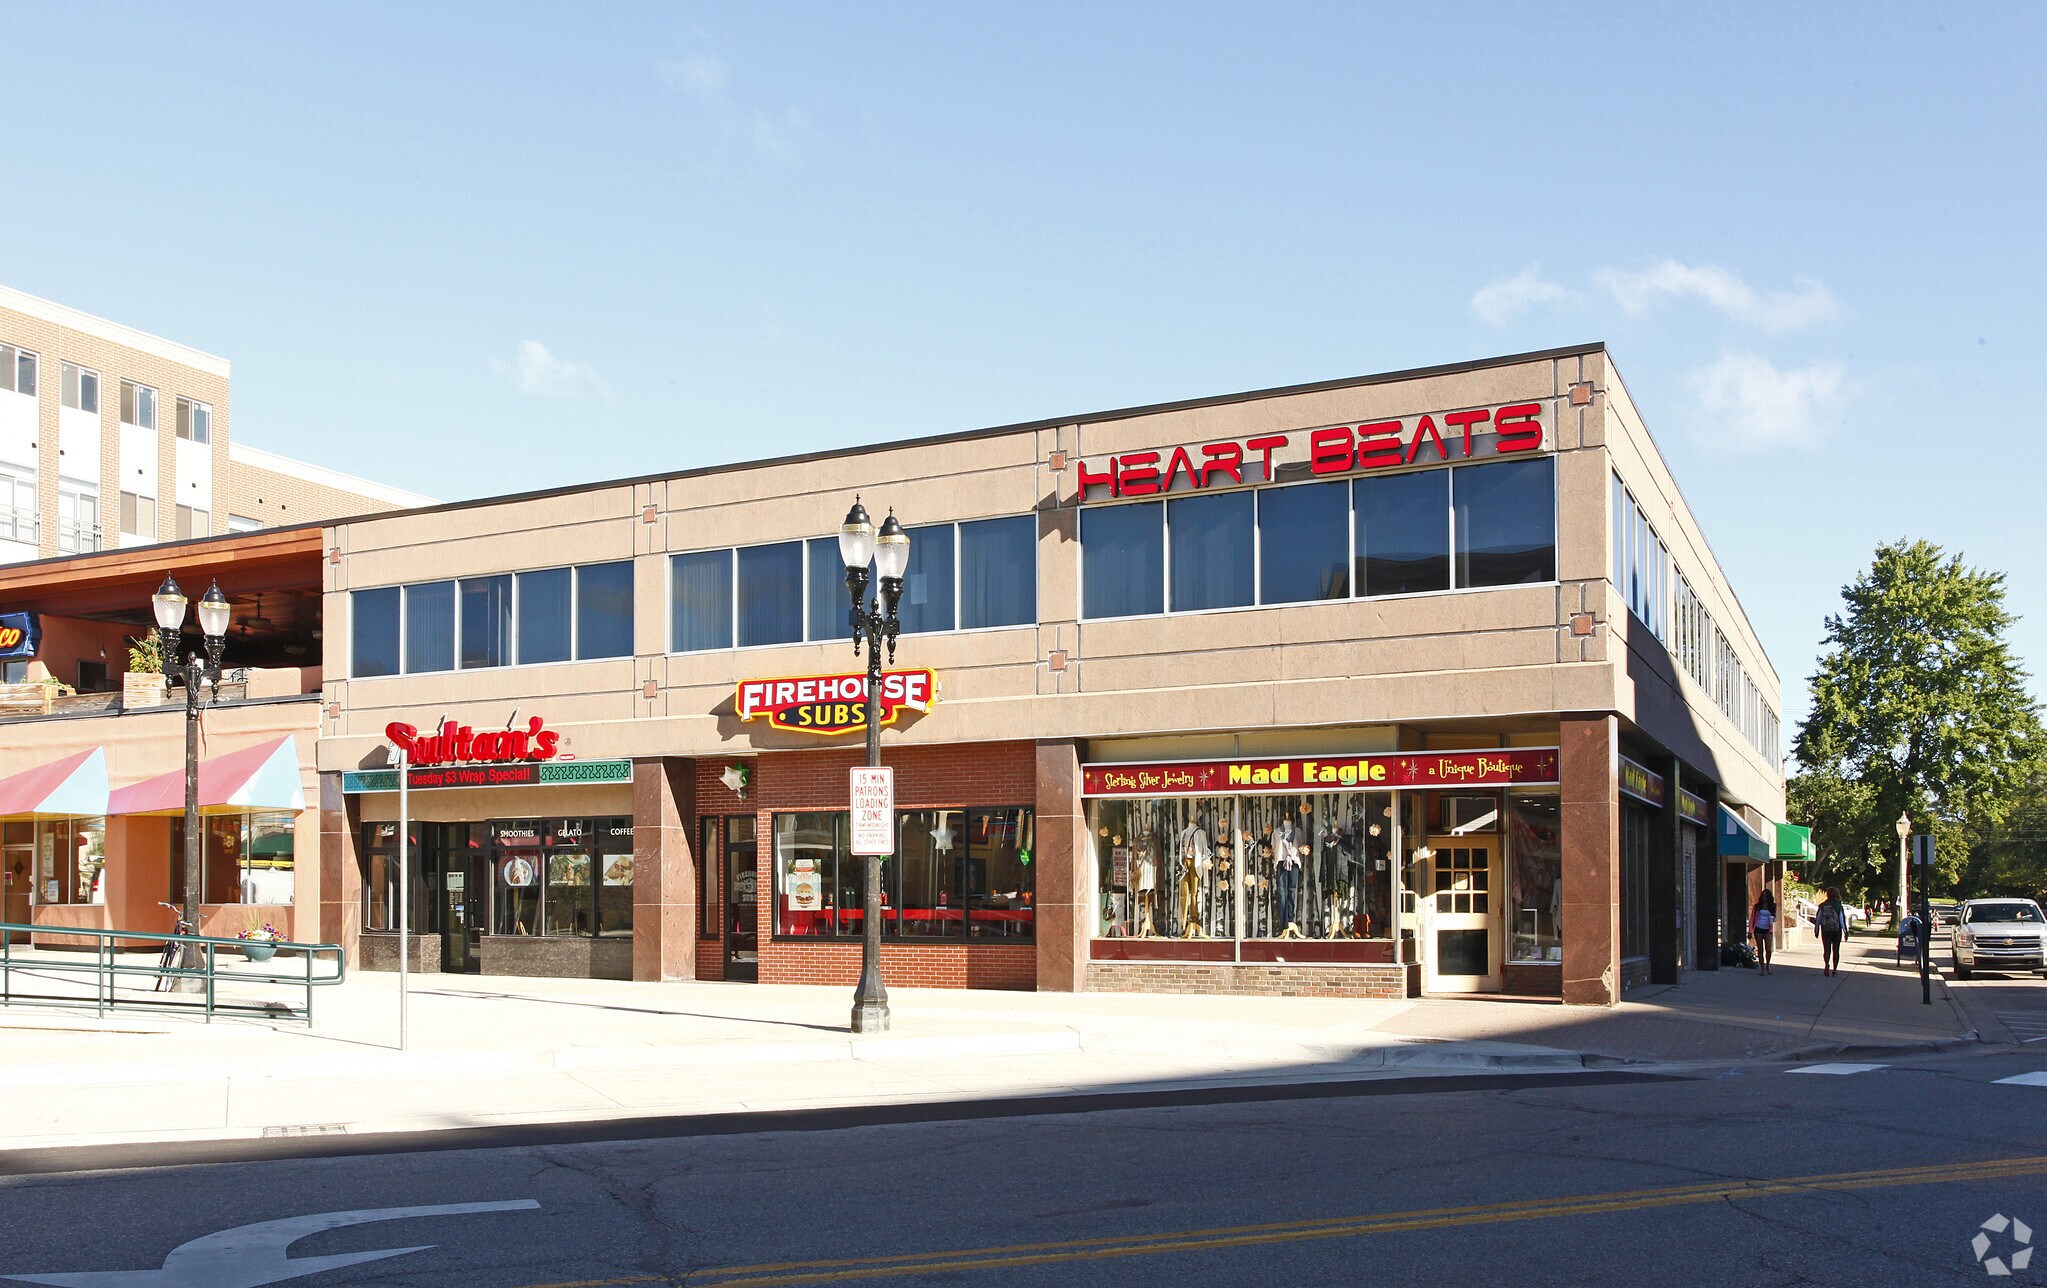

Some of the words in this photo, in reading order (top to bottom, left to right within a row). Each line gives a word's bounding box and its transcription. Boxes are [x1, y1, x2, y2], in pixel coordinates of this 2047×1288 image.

[1078, 435, 1288, 500] HEART
[1310, 402, 1543, 475] BEATS
[0, 627, 20, 647] co
[743, 673, 926, 720] FIREHOSE
[798, 703, 865, 726] SUBS
[385, 716, 560, 765] Sultan's
[407, 772, 443, 787] Tuesday
[445, 770, 457, 784] $3
[459, 770, 486, 785] Wrap
[488, 767, 531, 784] Special!
[1228, 763, 1289, 785] Mad
[1303, 760, 1386, 786] Eagle
[1428, 767, 1436, 775] a
[1438, 758, 1475, 780] Unique
[1477, 757, 1523, 779] Boutique
[859, 774, 867, 785] 15
[871, 774, 885, 785] MIN
[1104, 772, 1137, 790] Sterling
[1138, 771, 1160, 790] Silver
[1161, 770, 1194, 789] Jewelry
[855, 785, 889, 797] PATRONS
[855, 798, 889, 809] LOADING
[861, 810, 883, 821] ZONE
[500, 829, 535, 838] SMOOTHIES
[557, 828, 582, 838] GELATO
[610, 828, 633, 836] COFFEE
